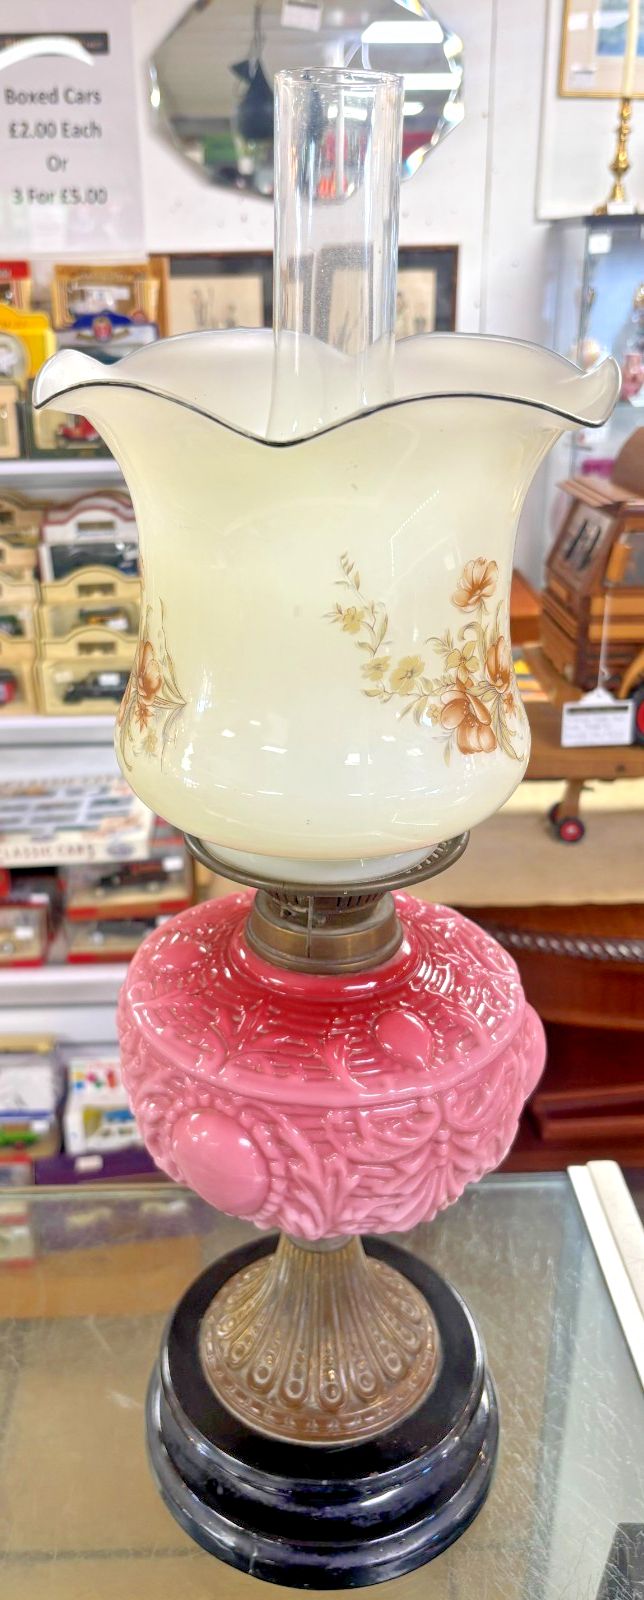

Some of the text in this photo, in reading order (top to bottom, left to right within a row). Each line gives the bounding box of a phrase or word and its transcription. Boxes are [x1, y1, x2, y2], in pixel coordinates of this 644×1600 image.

[4, 87, 102, 105] Boxed Cars
[9, 121, 102, 139] £2.00 Each
[46, 154, 68, 172] Or
[13, 187, 108, 204] 3 For £5.00
